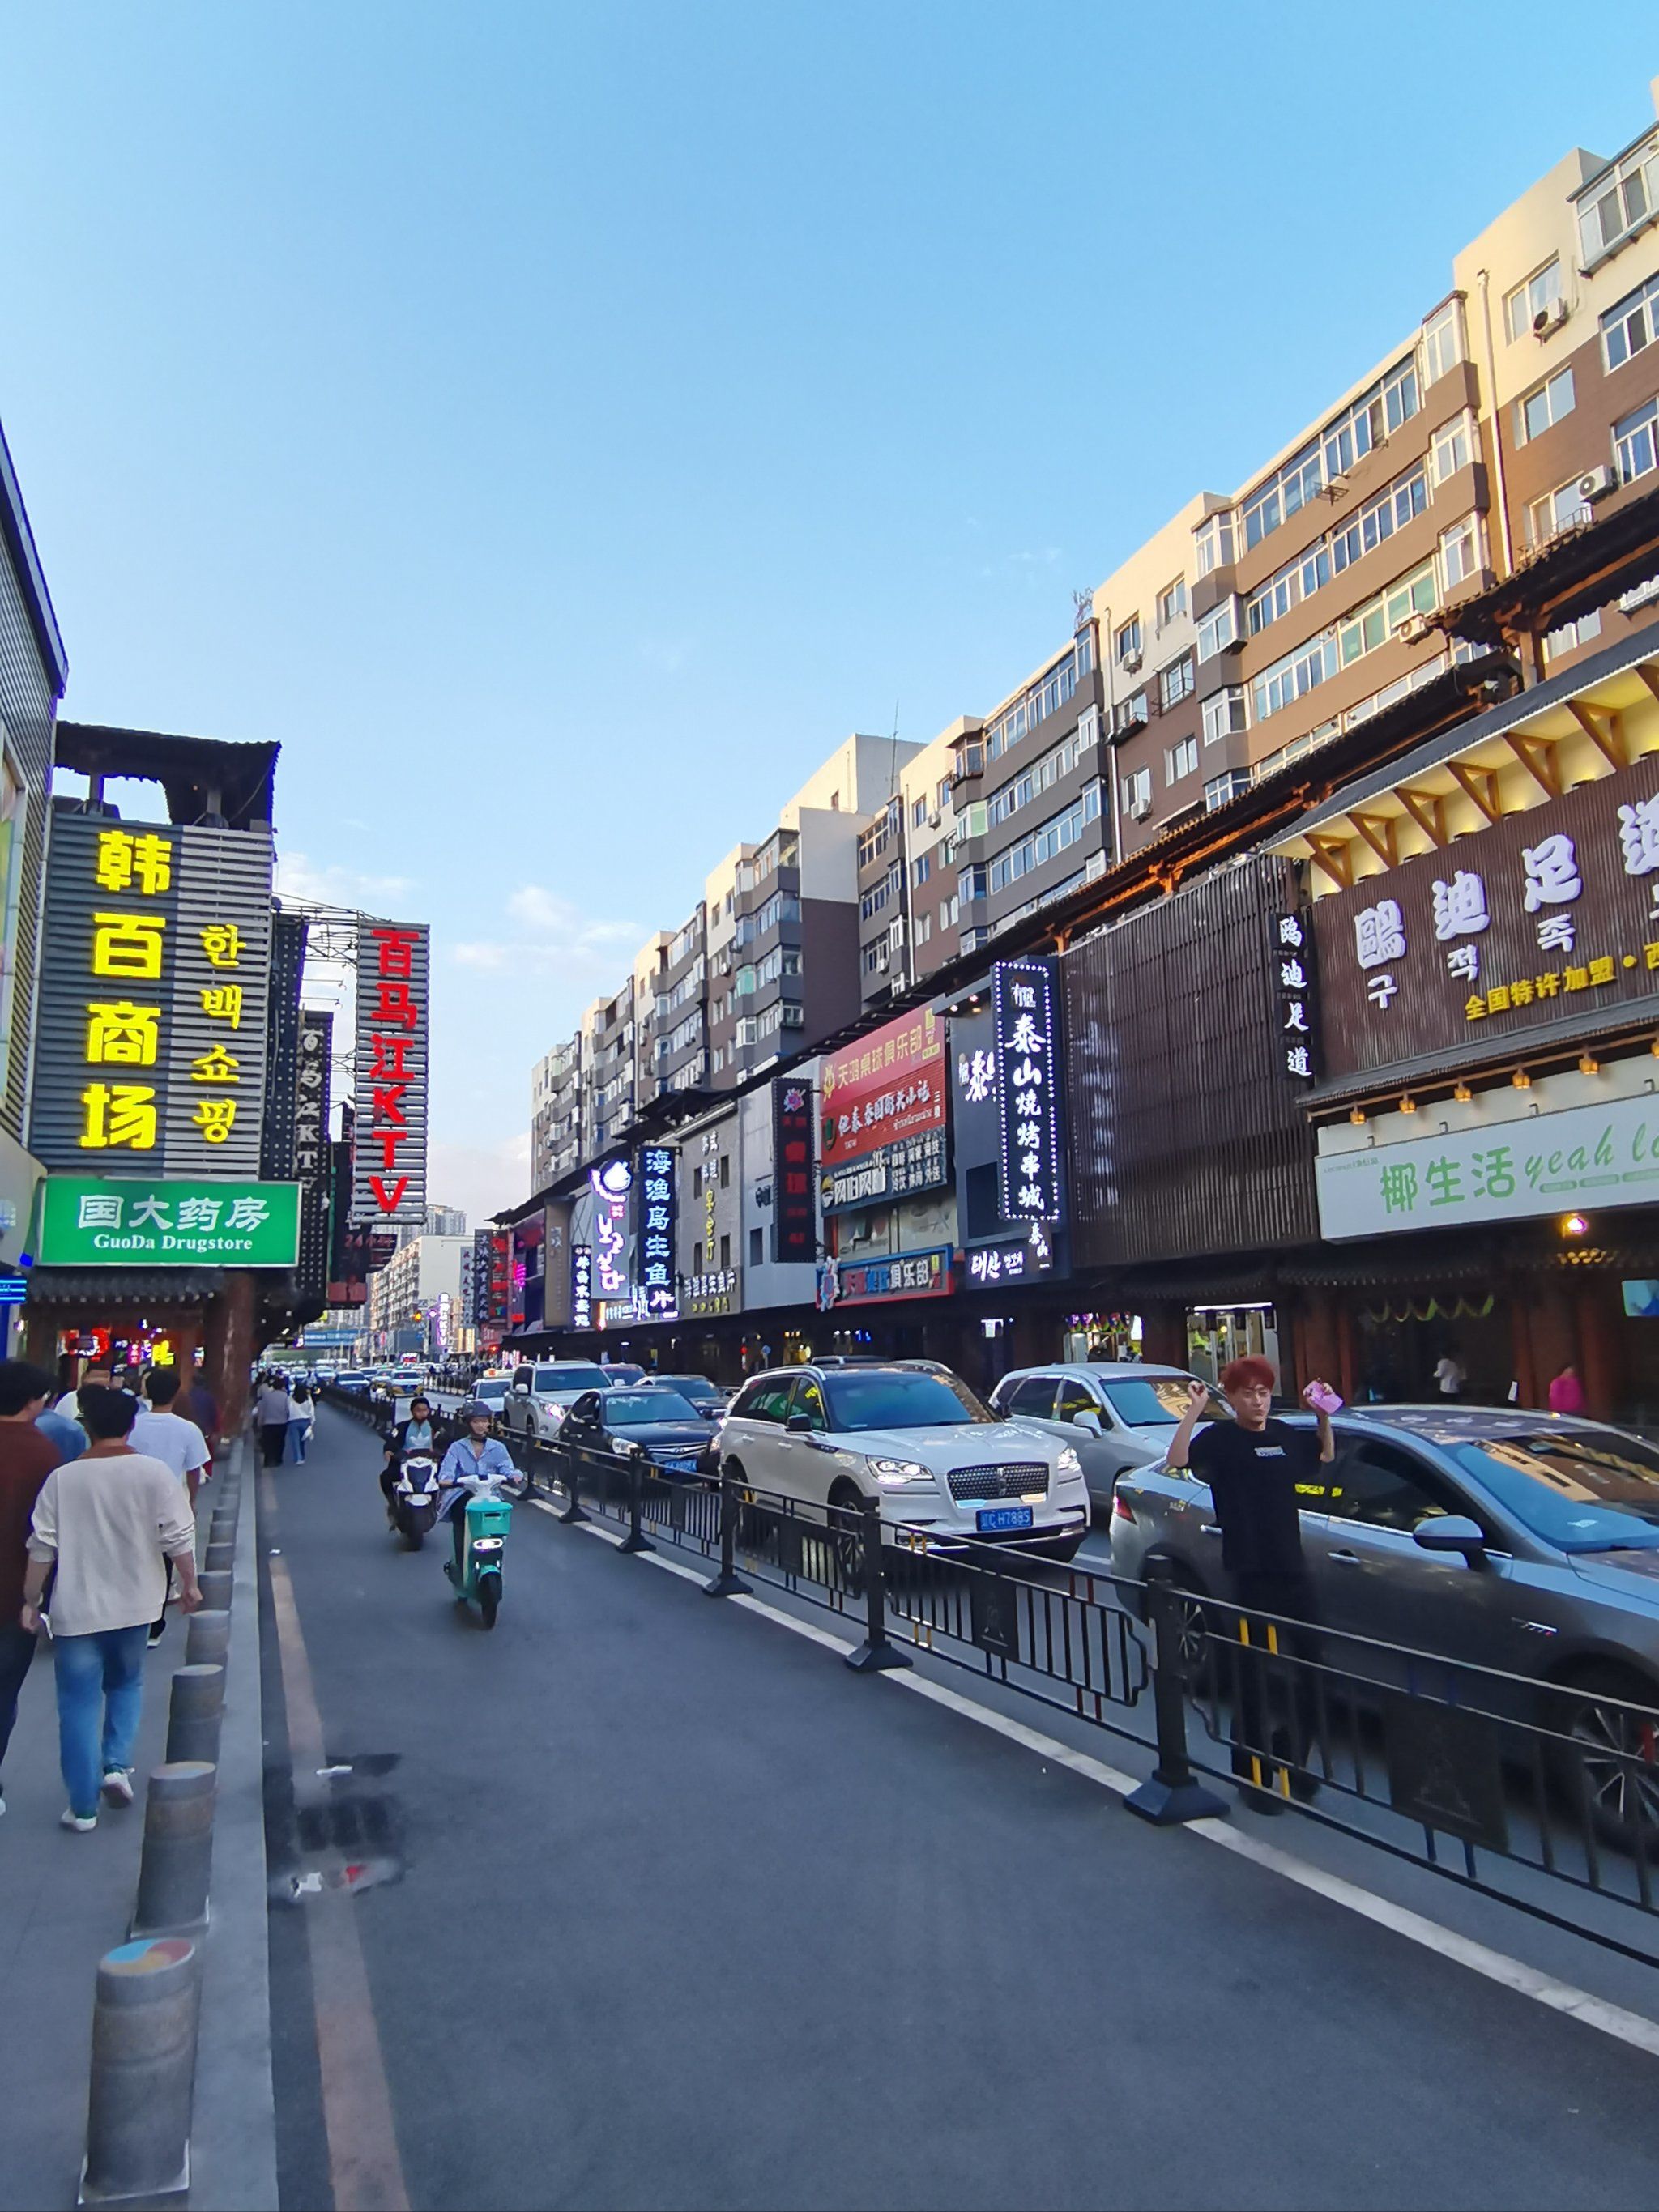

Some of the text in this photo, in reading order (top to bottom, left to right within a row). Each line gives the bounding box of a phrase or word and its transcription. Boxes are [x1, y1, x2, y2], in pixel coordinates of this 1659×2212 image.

[79, 830, 172, 1150] 韩百商场
[369, 928, 420, 1213] 百马江KTV
[1380, 1145, 1516, 1213] 椰生活
[1525, 1124, 1614, 1189] yeah
[78, 1194, 270, 1231] 国大药房
[94, 1234, 253, 1253] GuoDa Drugstore
